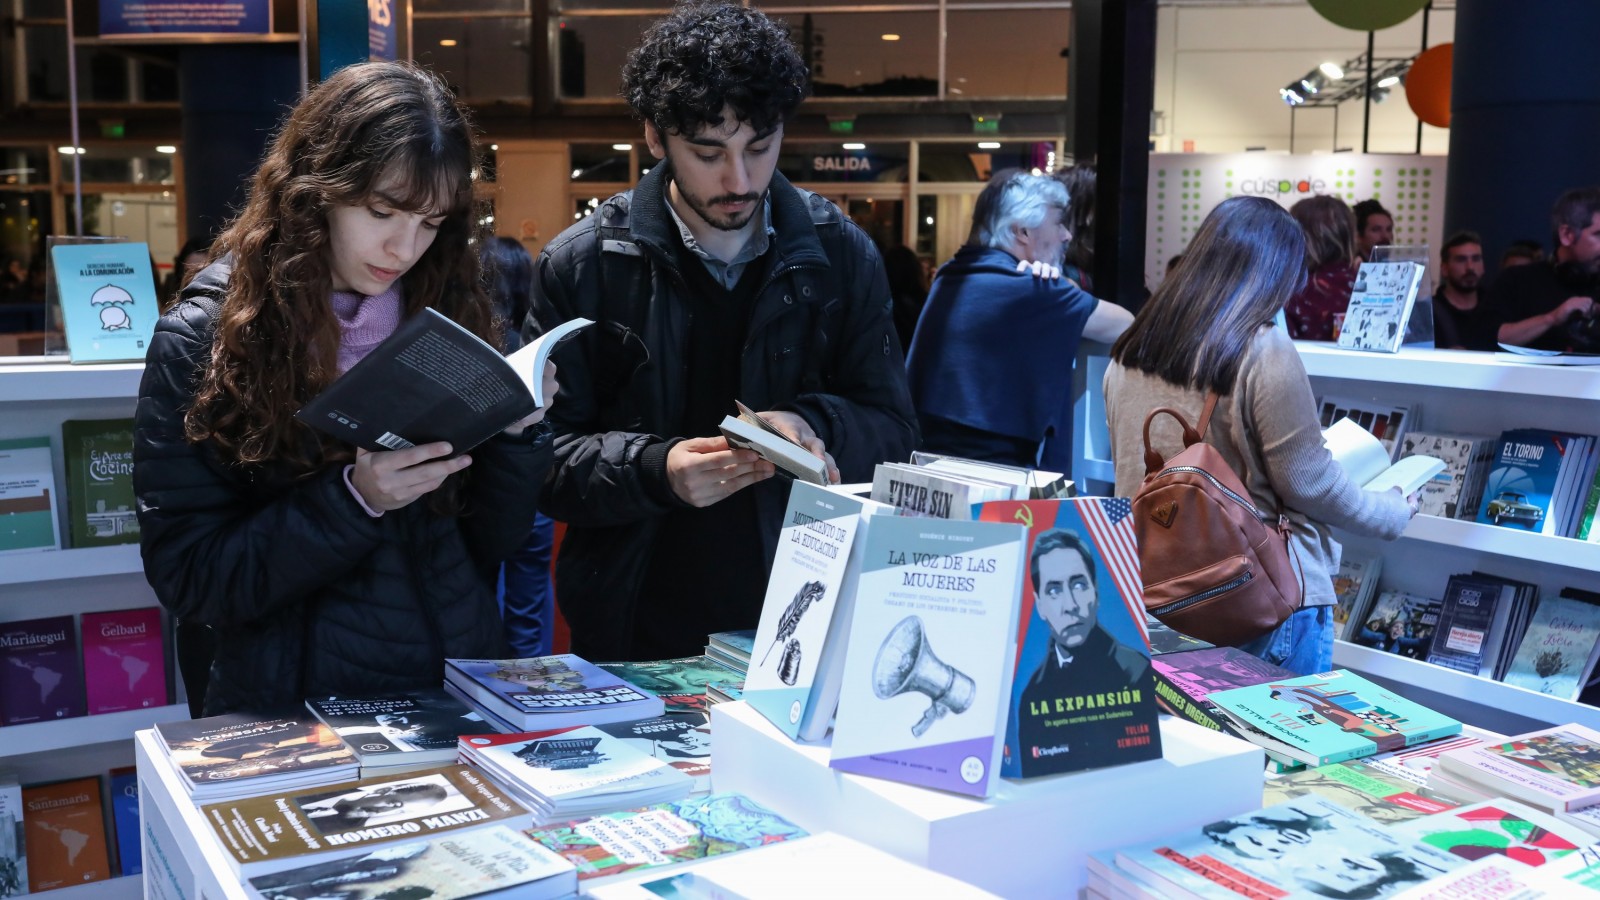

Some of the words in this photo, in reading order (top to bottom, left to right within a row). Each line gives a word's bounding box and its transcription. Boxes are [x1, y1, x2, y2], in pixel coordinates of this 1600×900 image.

[814, 157, 870, 171] SALIDA
[1241, 177, 1325, 198] cúspide
[93, 267, 134, 275] COMUNICACIÓN
[102, 451, 122, 463] Arte
[123, 452, 132, 460] de
[1503, 442, 1512, 456] EL
[1514, 443, 1544, 460] TORINO
[889, 480, 928, 512] VIVIR
[929, 490, 953, 519] SIN
[793, 511, 836, 538] MOVIMIENTO
[836, 530, 847, 542] DE
[791, 529, 800, 543] LA
[801, 533, 839, 559] EDUCACIÓN
[888, 551, 909, 565] LA
[913, 553, 939, 568] VOZ
[943, 556, 963, 570] DE
[967, 558, 996, 573] LAS
[902, 572, 975, 592] MUJERES
[101, 623, 146, 637] Gelbard
[1549, 617, 1583, 633] Cartas
[0, 630, 66, 647] Mariátegui
[513, 690, 604, 701] VERDAD
[525, 692, 644, 707] MACHOS
[1031, 701, 1049, 715] LA
[1056, 686, 1141, 712] EXPANSIÓN
[1155, 681, 1185, 711] AMORES
[1184, 703, 1221, 731] URGENTES
[193, 725, 273, 742] AUSENCIA
[278, 721, 298, 729] LA
[324, 822, 421, 846] HOMERO
[421, 808, 491, 830] MANZI
